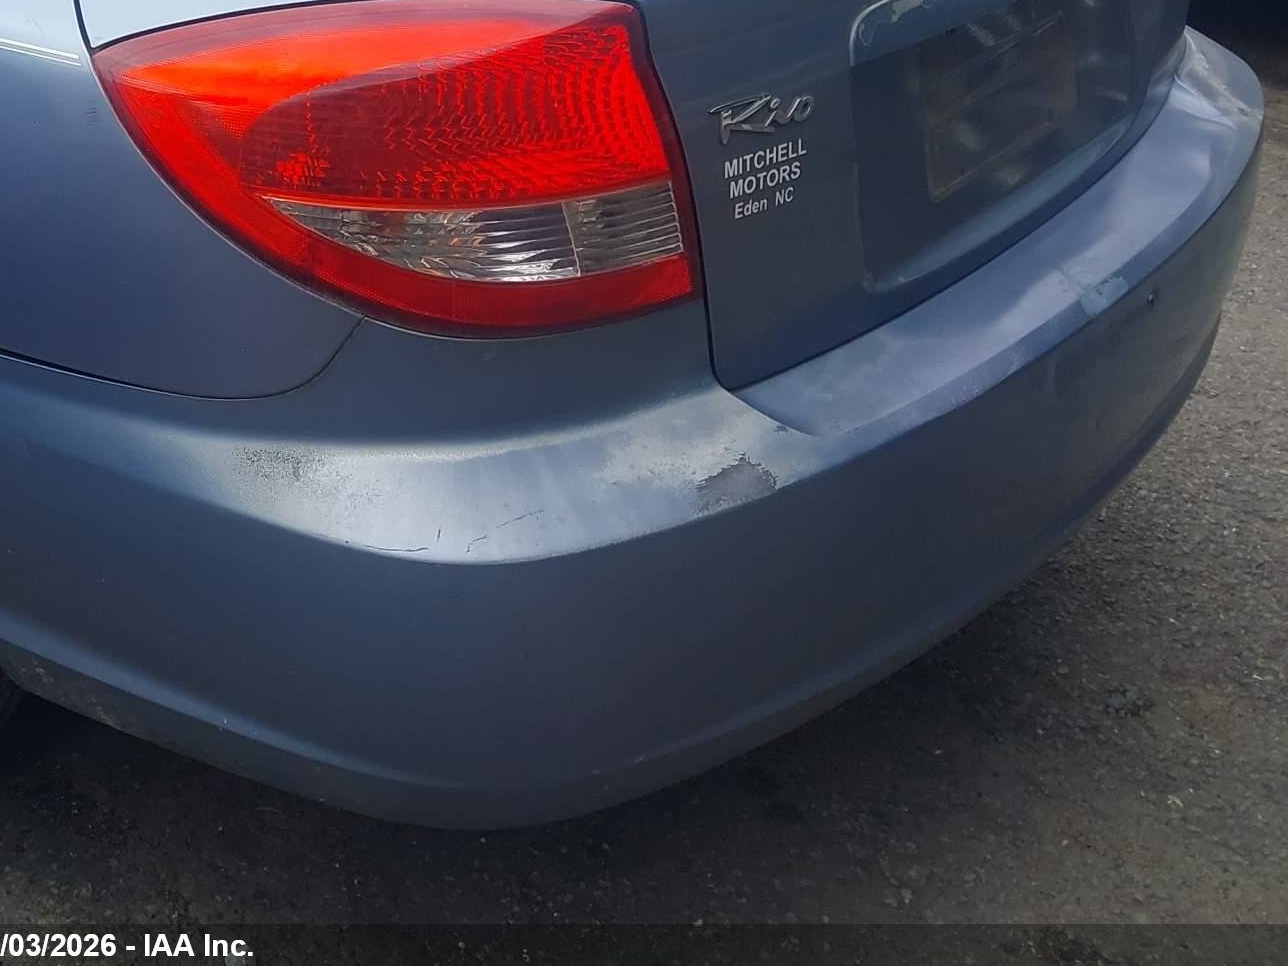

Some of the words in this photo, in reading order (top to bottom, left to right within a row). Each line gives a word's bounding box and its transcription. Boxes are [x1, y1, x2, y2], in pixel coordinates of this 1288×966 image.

[709, 94, 814, 145] Rio
[724, 138, 807, 179] MITCHELL
[729, 162, 801, 199] MOTORS
[734, 199, 768, 219] Eden
[775, 187, 794, 206] NC
